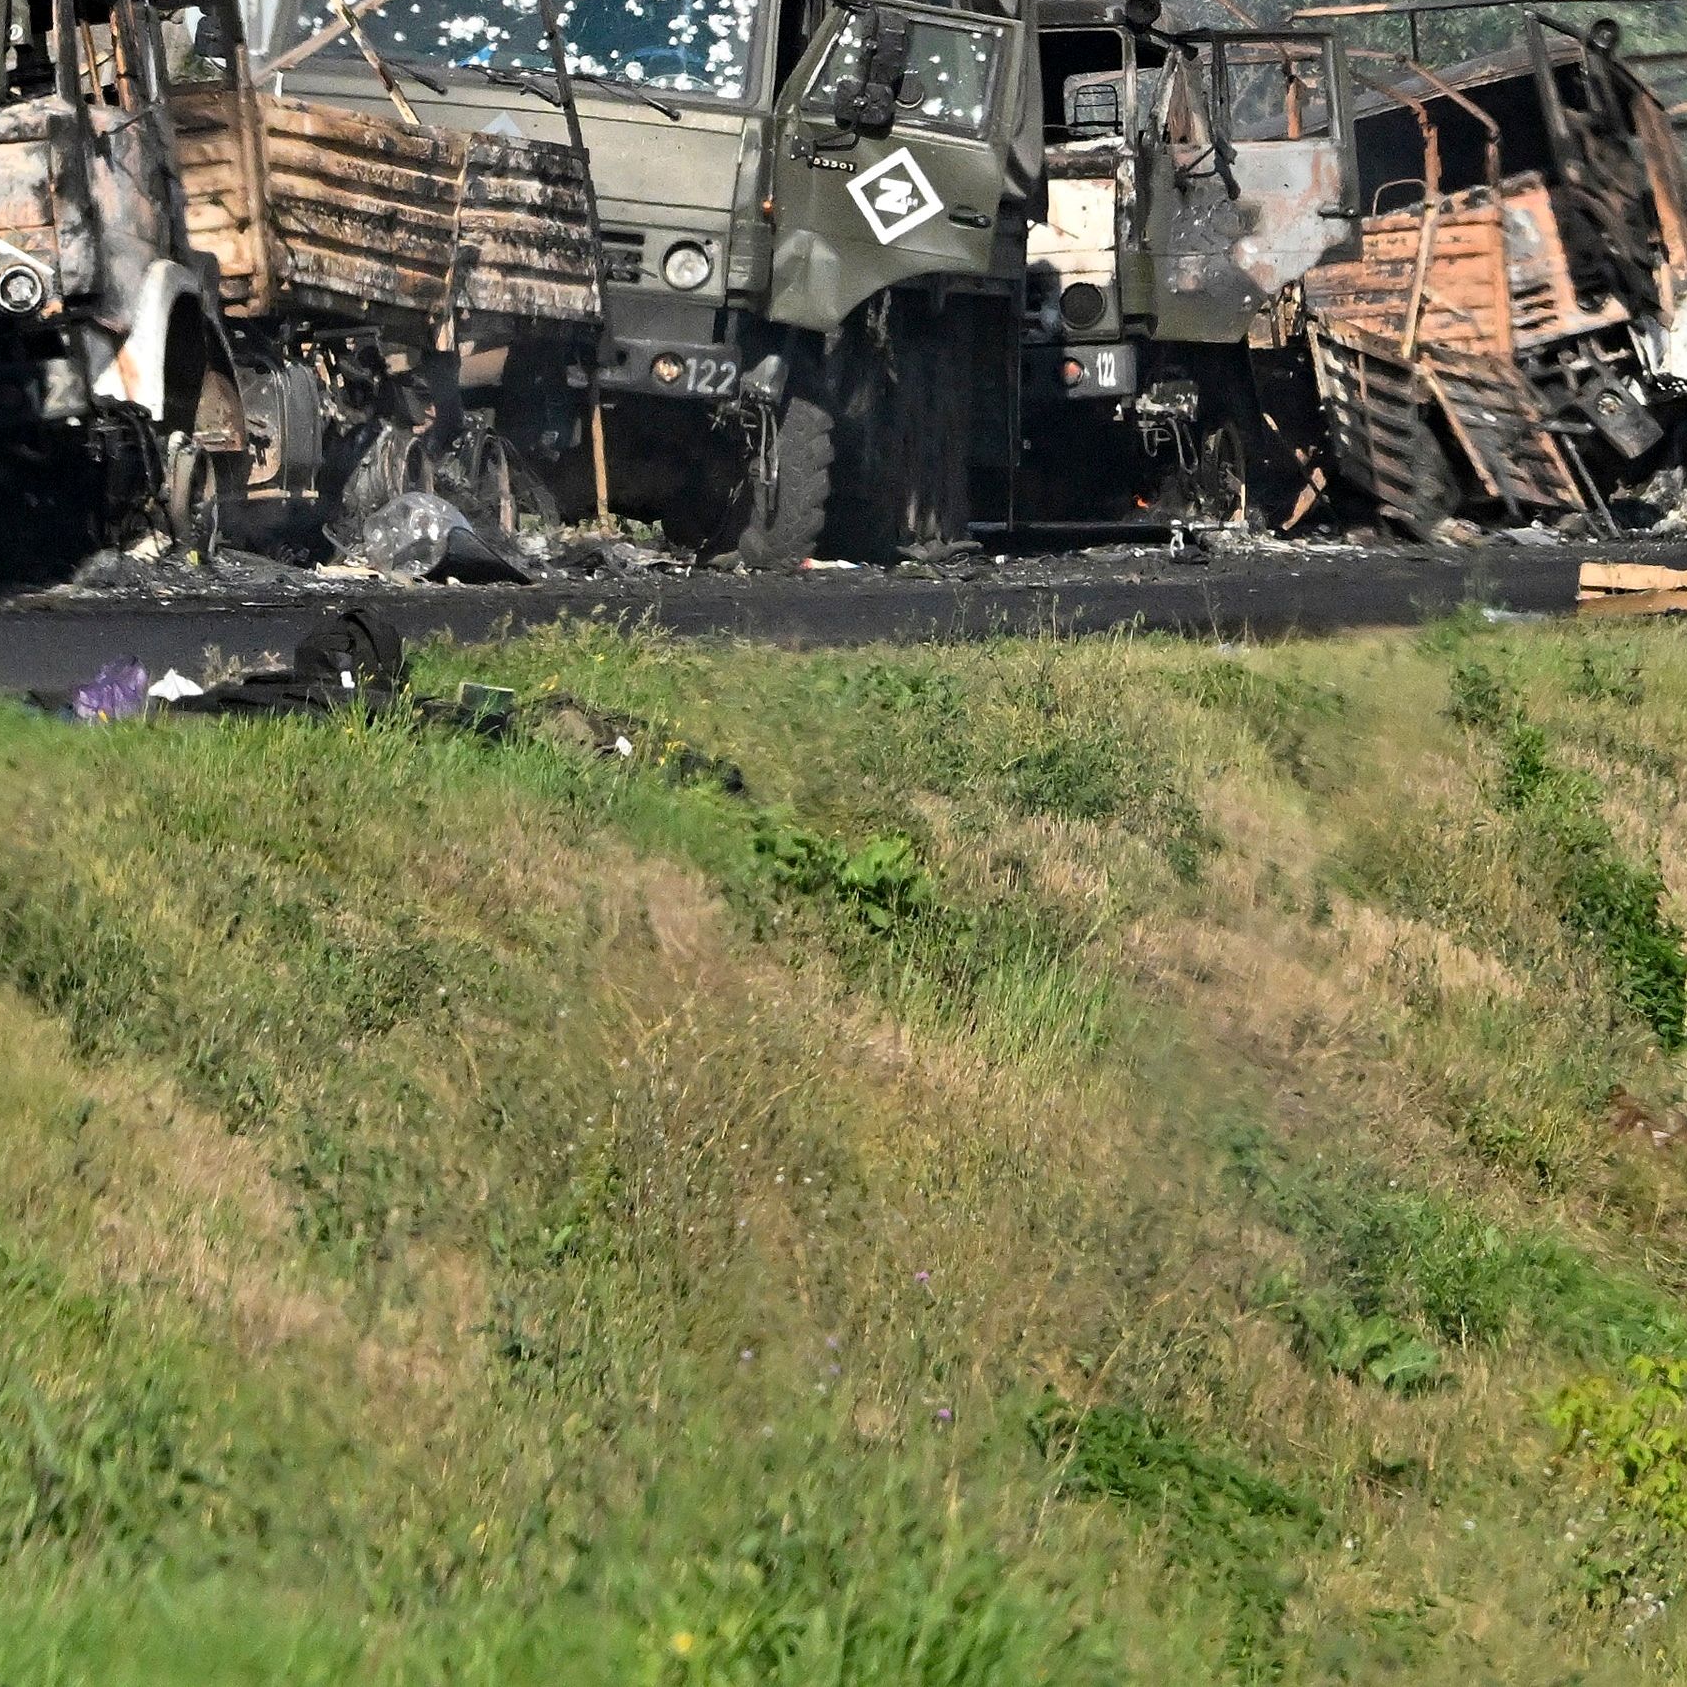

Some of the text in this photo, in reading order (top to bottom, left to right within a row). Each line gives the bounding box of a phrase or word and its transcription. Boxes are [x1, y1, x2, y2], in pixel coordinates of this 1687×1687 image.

[813, 157, 854, 172] 53501
[686, 357, 736, 394] 122
[1096, 352, 1116, 387] 122
